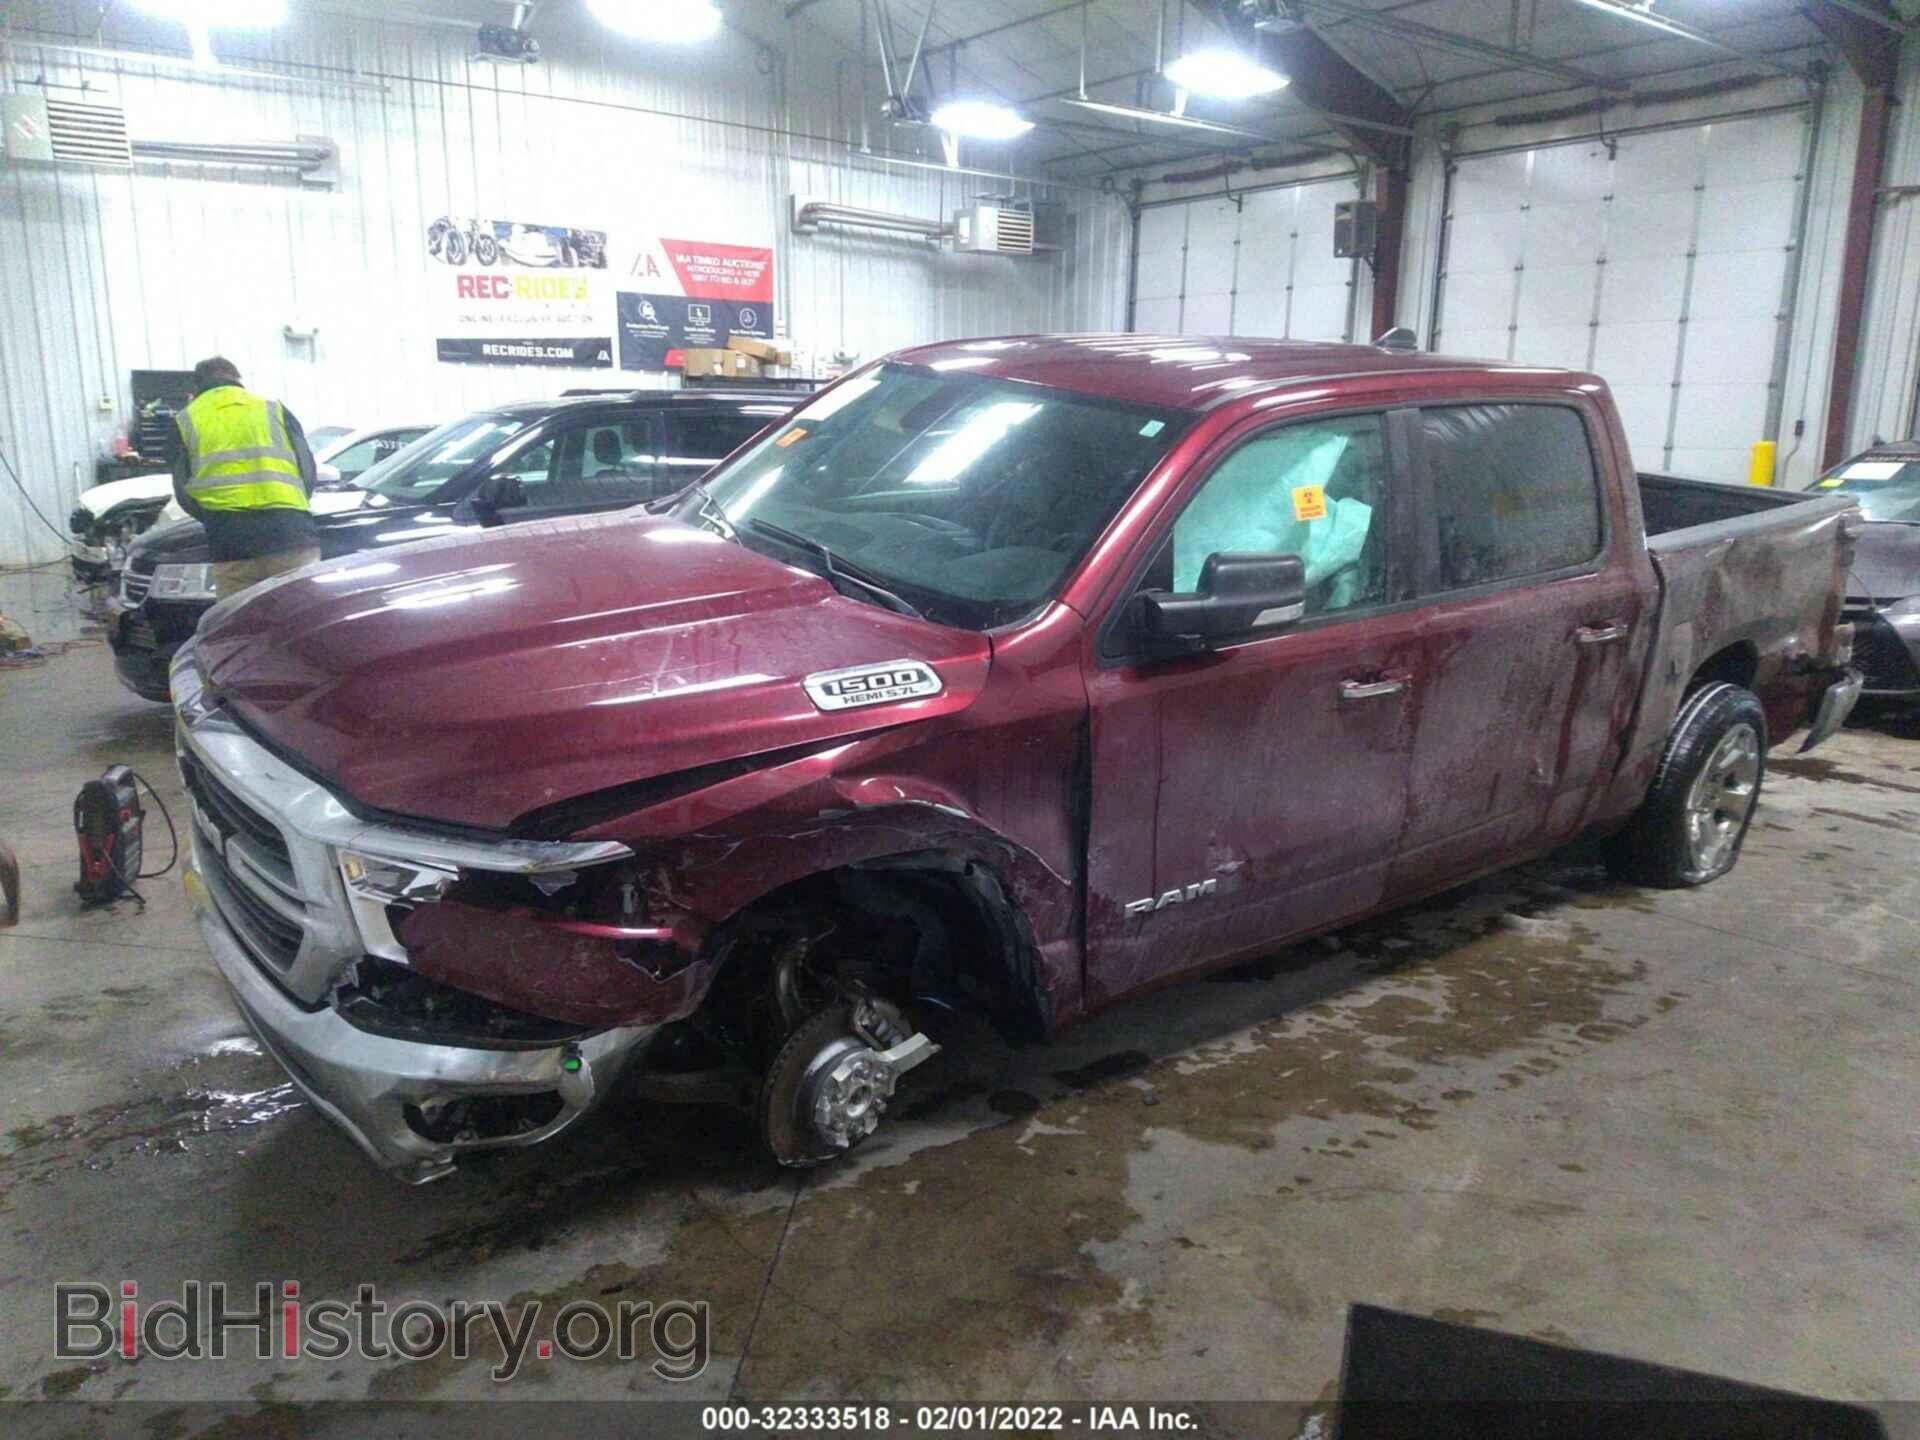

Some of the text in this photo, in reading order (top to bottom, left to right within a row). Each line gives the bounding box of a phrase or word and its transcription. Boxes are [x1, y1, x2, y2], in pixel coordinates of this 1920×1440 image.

[457, 274, 509, 299] REC
[482, 343, 574, 359] RECRIDES.COM
[826, 668, 920, 696] 1500
[842, 685, 919, 705] HEMI 5.7L
[1124, 878, 1217, 919] RAM
